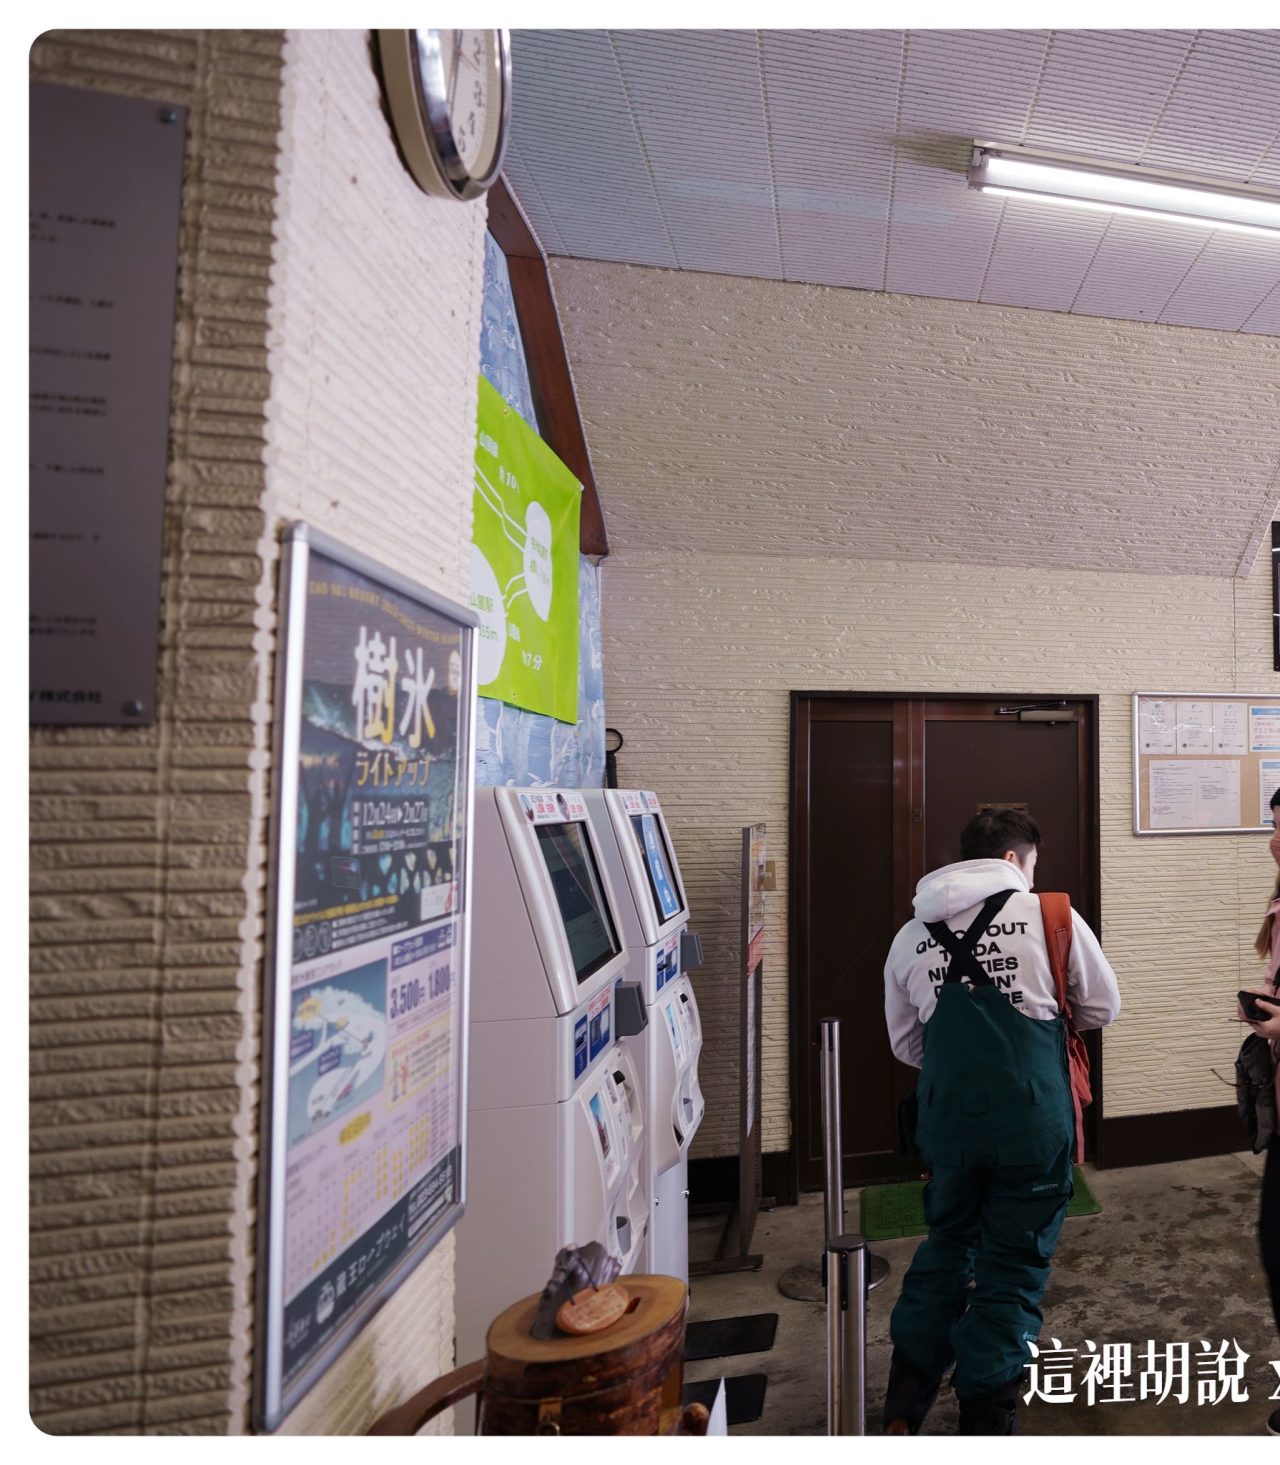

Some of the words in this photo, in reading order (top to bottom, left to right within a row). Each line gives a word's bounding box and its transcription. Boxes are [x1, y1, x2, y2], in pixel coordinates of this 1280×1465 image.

[352, 625, 436, 750] 樹氷
[355, 752, 433, 787] ライトアップ
